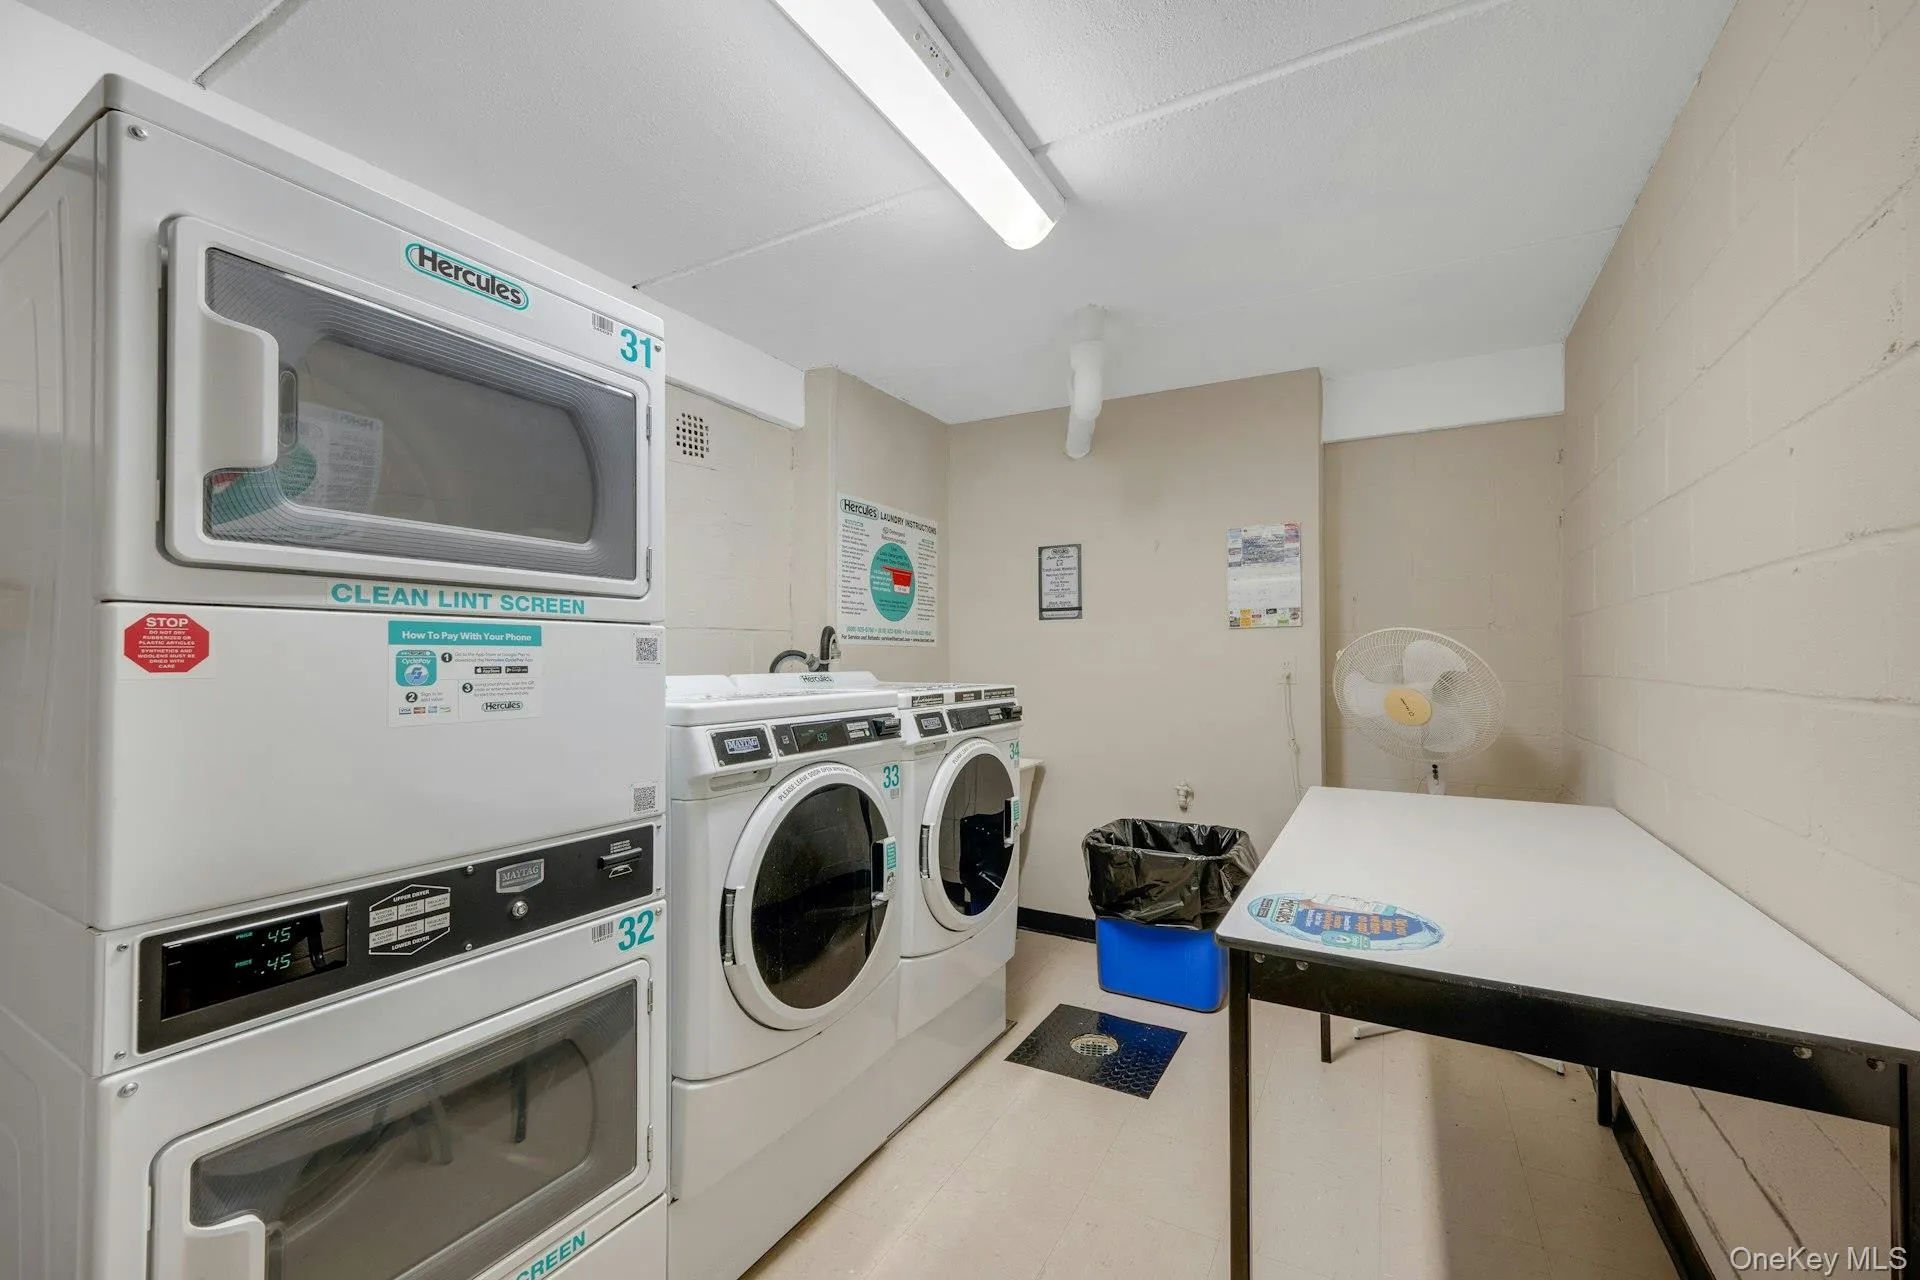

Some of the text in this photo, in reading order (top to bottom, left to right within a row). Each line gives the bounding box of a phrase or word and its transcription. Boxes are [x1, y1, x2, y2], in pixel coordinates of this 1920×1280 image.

[418, 244, 522, 306] Hercules
[620, 329, 651, 369] 31
[844, 499, 937, 535] Hercules LAUNDRY INSTRUCTIONS
[331, 583, 585, 615] CLEAN LINT SCREEN
[146, 617, 188, 628] STOP
[402, 631, 532, 642] How To Pay With Your Phone
[801, 674, 833, 684] Hercules
[485, 702, 521, 711] Hercules
[727, 738, 758, 750] MAYTAG
[1010, 741, 1020, 760] 34
[883, 765, 899, 789] 33
[779, 784, 797, 801] PLEASE
[795, 774, 809, 786] LEAVE
[502, 866, 539, 881] MAYTAG
[393, 890, 430, 903] UPPER DRYER
[619, 910, 655, 951] 32
[392, 936, 430, 951] LOWER DRYER
